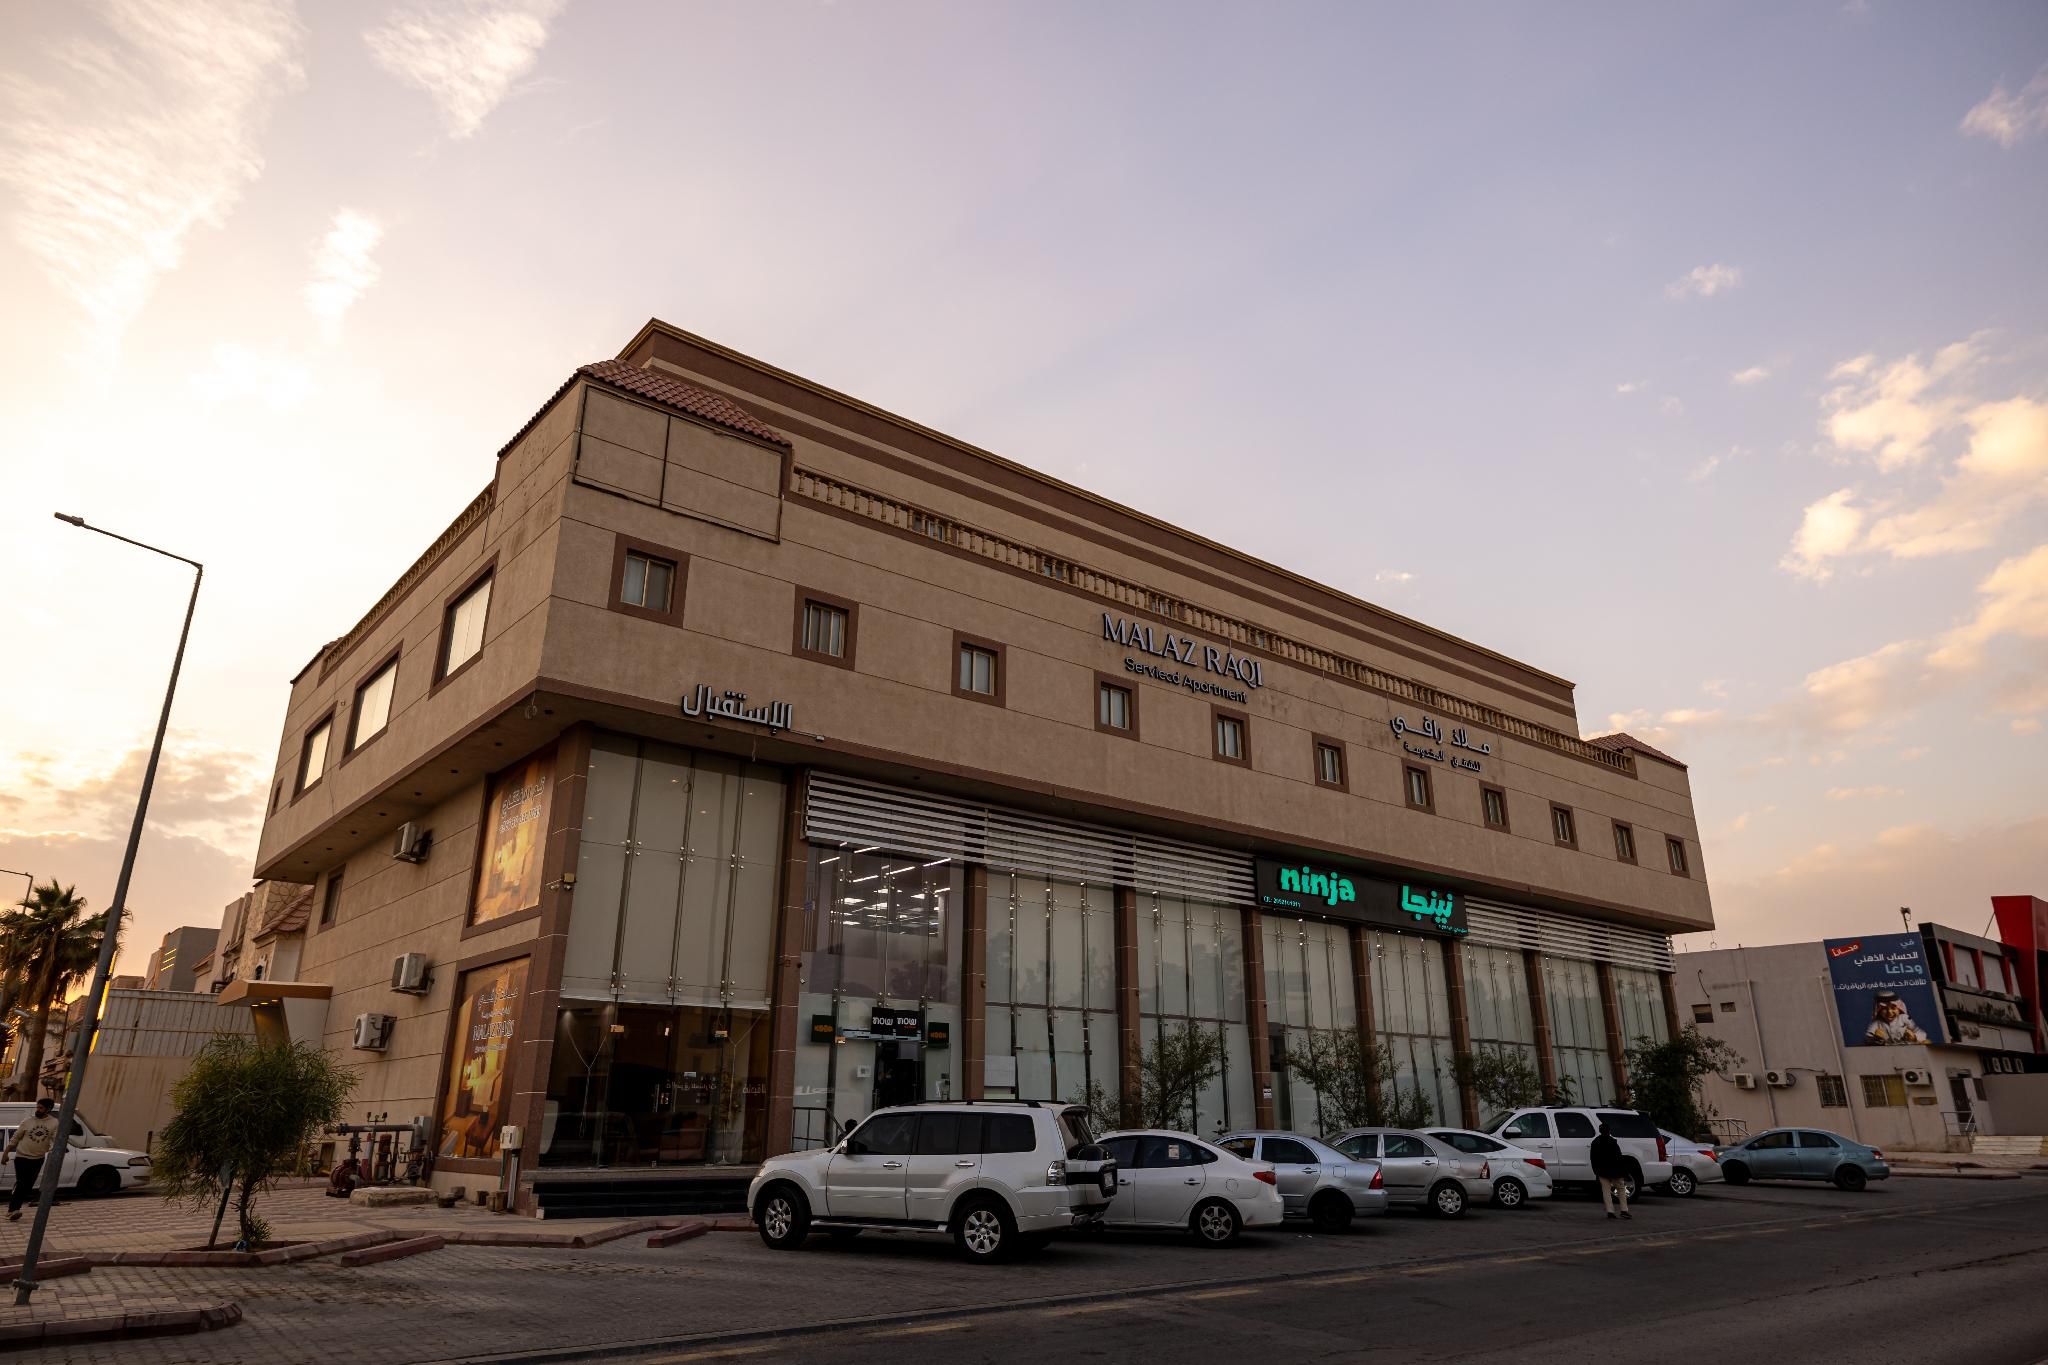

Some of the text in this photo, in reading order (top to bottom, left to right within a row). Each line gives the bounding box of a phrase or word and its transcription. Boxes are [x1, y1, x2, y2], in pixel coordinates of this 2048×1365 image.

[1103, 613, 1263, 688] MALAZ RAQI
[1183, 676, 1247, 704] Apartment
[682, 684, 793, 734] الإستقبال
[1452, 728, 1491, 754] ملاذ
[1280, 866, 1356, 906] ninja
[1402, 885, 1454, 924] نينجا
[1854, 951, 1919, 967] الحساب الذهني
[1900, 938, 1916, 950] في
